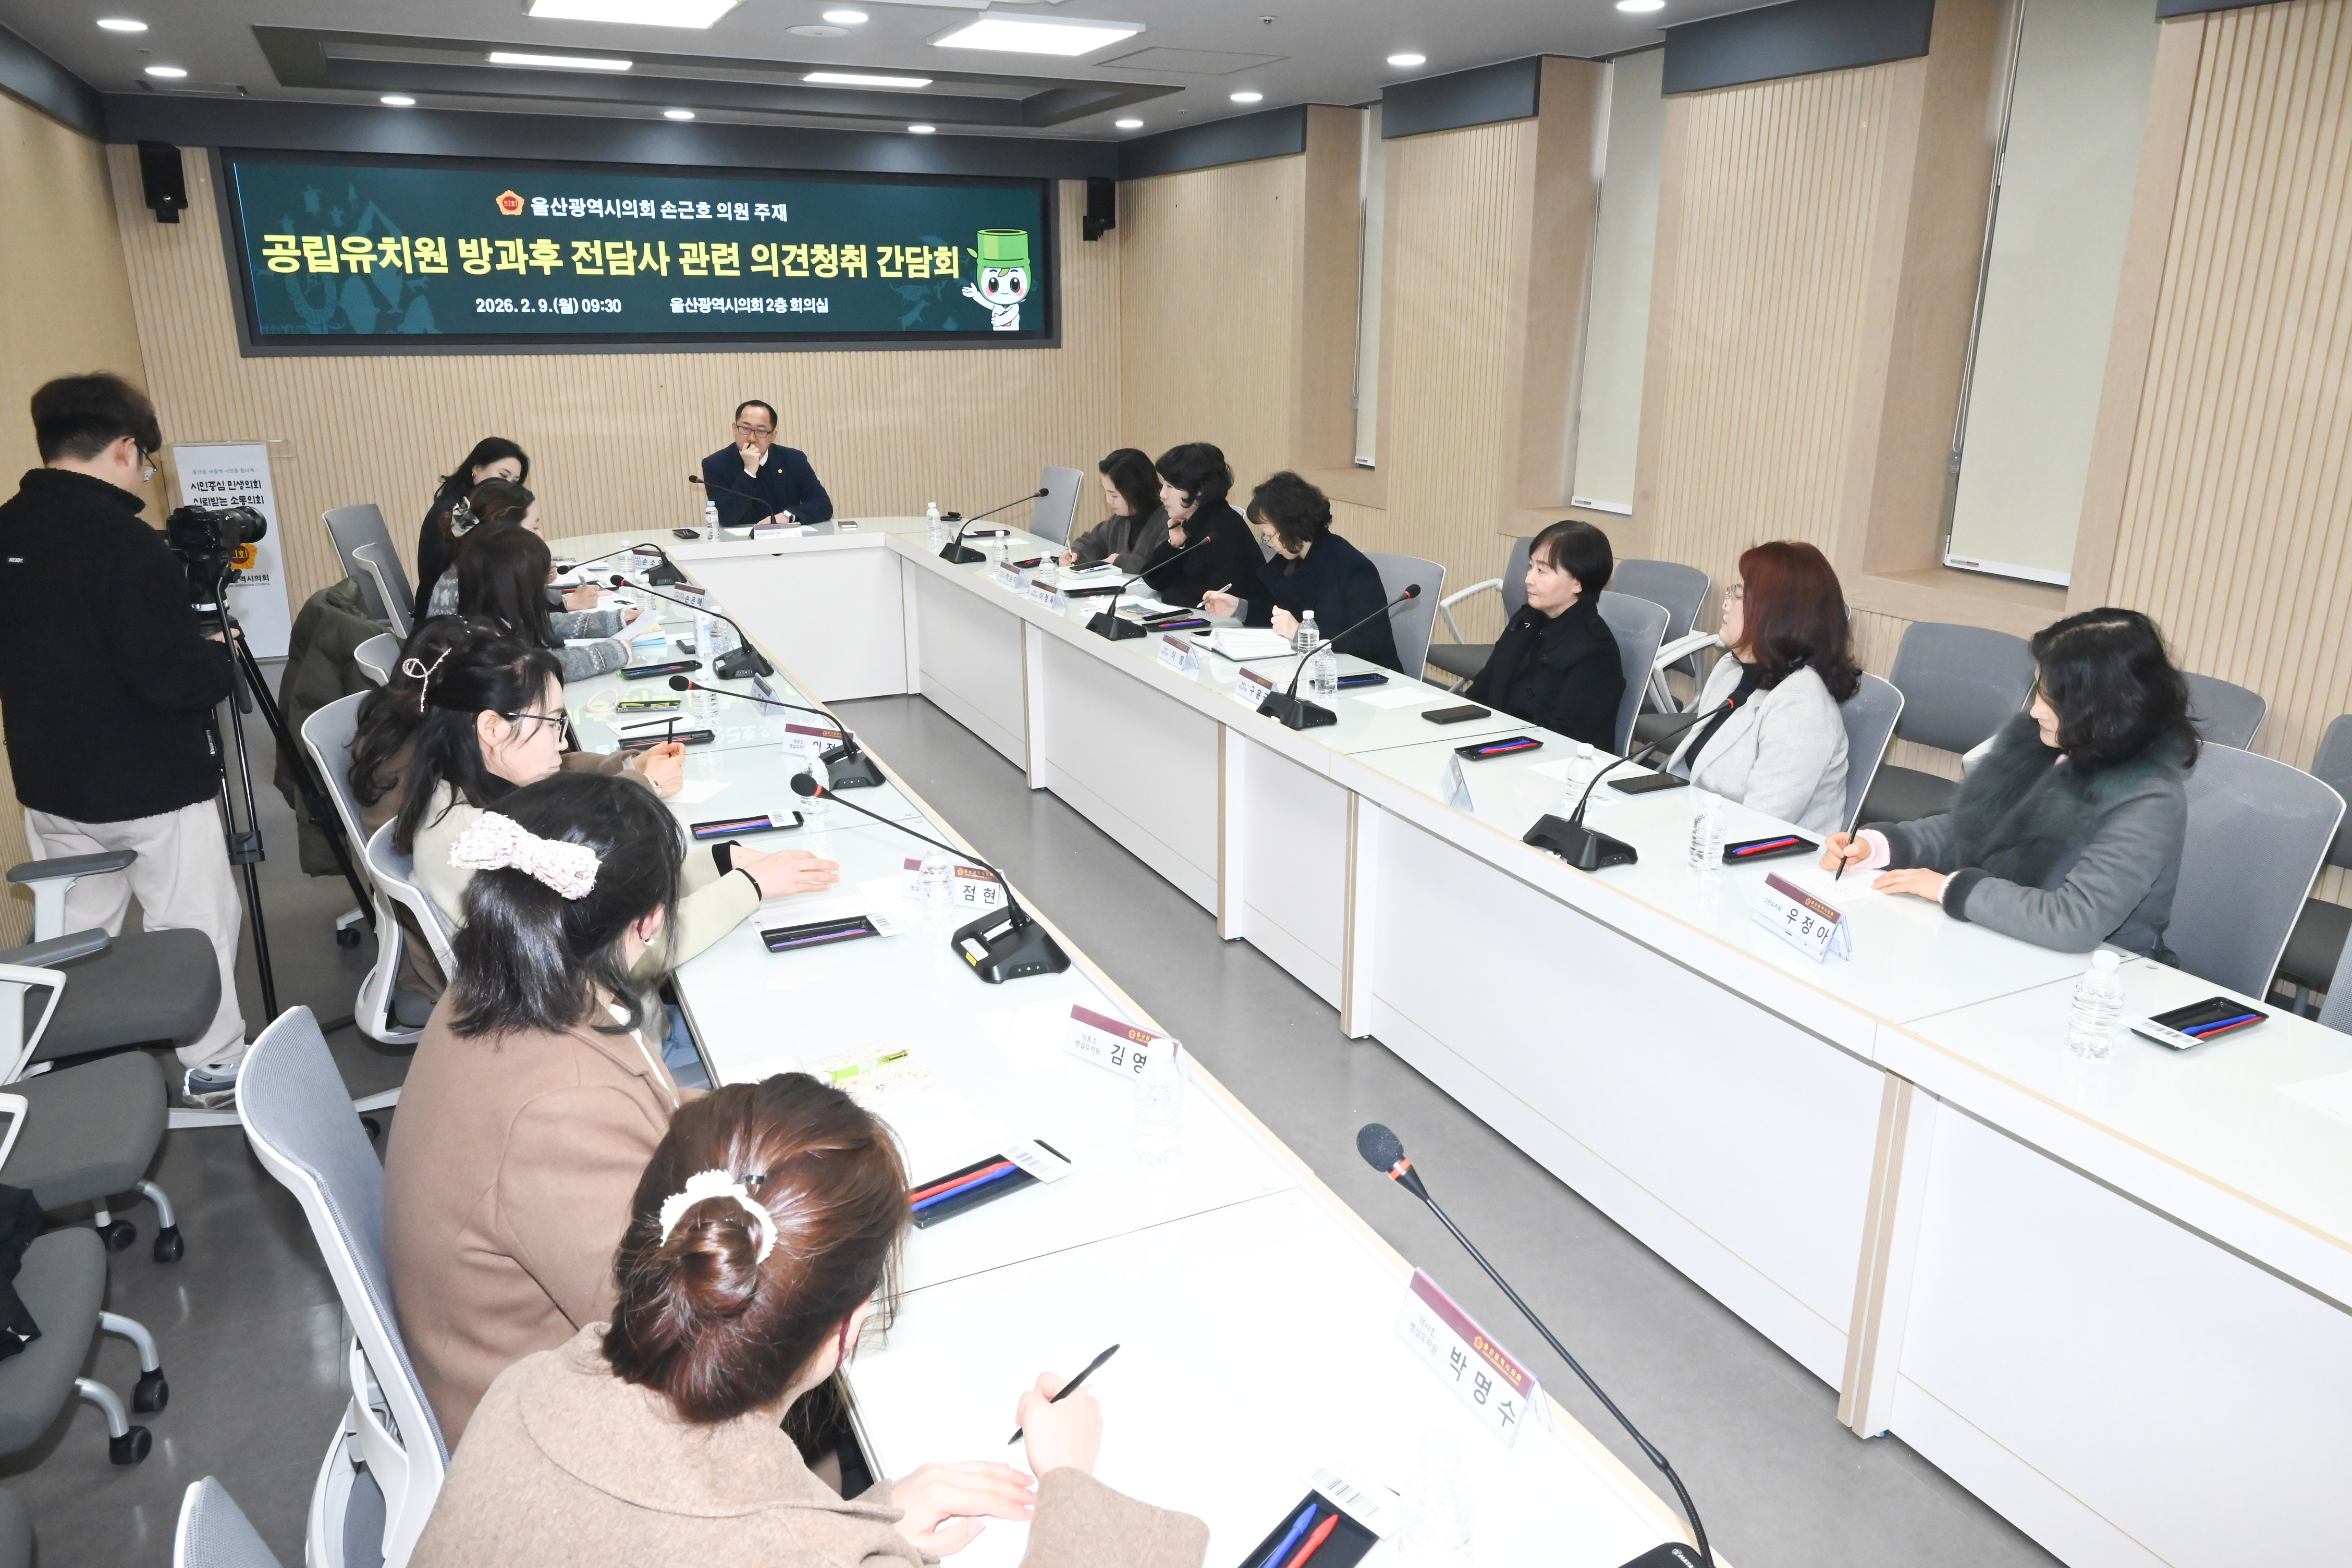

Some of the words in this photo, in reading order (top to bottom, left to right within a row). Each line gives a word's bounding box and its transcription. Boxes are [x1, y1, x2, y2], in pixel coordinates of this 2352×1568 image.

[531, 197, 656, 219] 울산광역시의회
[660, 200, 713, 219] 손근호
[716, 202, 749, 221] 의원
[754, 203, 787, 222] 주재
[262, 235, 449, 274] 공립유치원
[458, 237, 564, 275] 방과후
[571, 240, 670, 276] 전담사
[678, 241, 741, 276] 관련
[750, 242, 867, 278] 의견청취
[877, 245, 959, 279] 간담회
[475, 298, 518, 313] 2026.
[520, 298, 535, 313] 2.
[581, 298, 622, 313] 09:30
[669, 297, 764, 313] 울산광역시의회
[766, 297, 787, 313] 2층
[790, 298, 829, 313] 회의실
[191, 481, 225, 492] 시민중심
[227, 479, 262, 491] 민생의회
[193, 497, 227, 507] 신뢰받는
[230, 495, 264, 506] 소통의회
[234, 574, 270, 583] 역시의회
[1786, 909, 1830, 945] 우정아
[1075, 1040, 1101, 1056] 병설유치원
[1082, 1033, 1097, 1045] 성동초
[1111, 1044, 1147, 1074] 김영
[1410, 1321, 1438, 1355] 병설유치원
[1419, 1316, 1436, 1338] 약사초
[1450, 1346, 1515, 1427] 박명수
